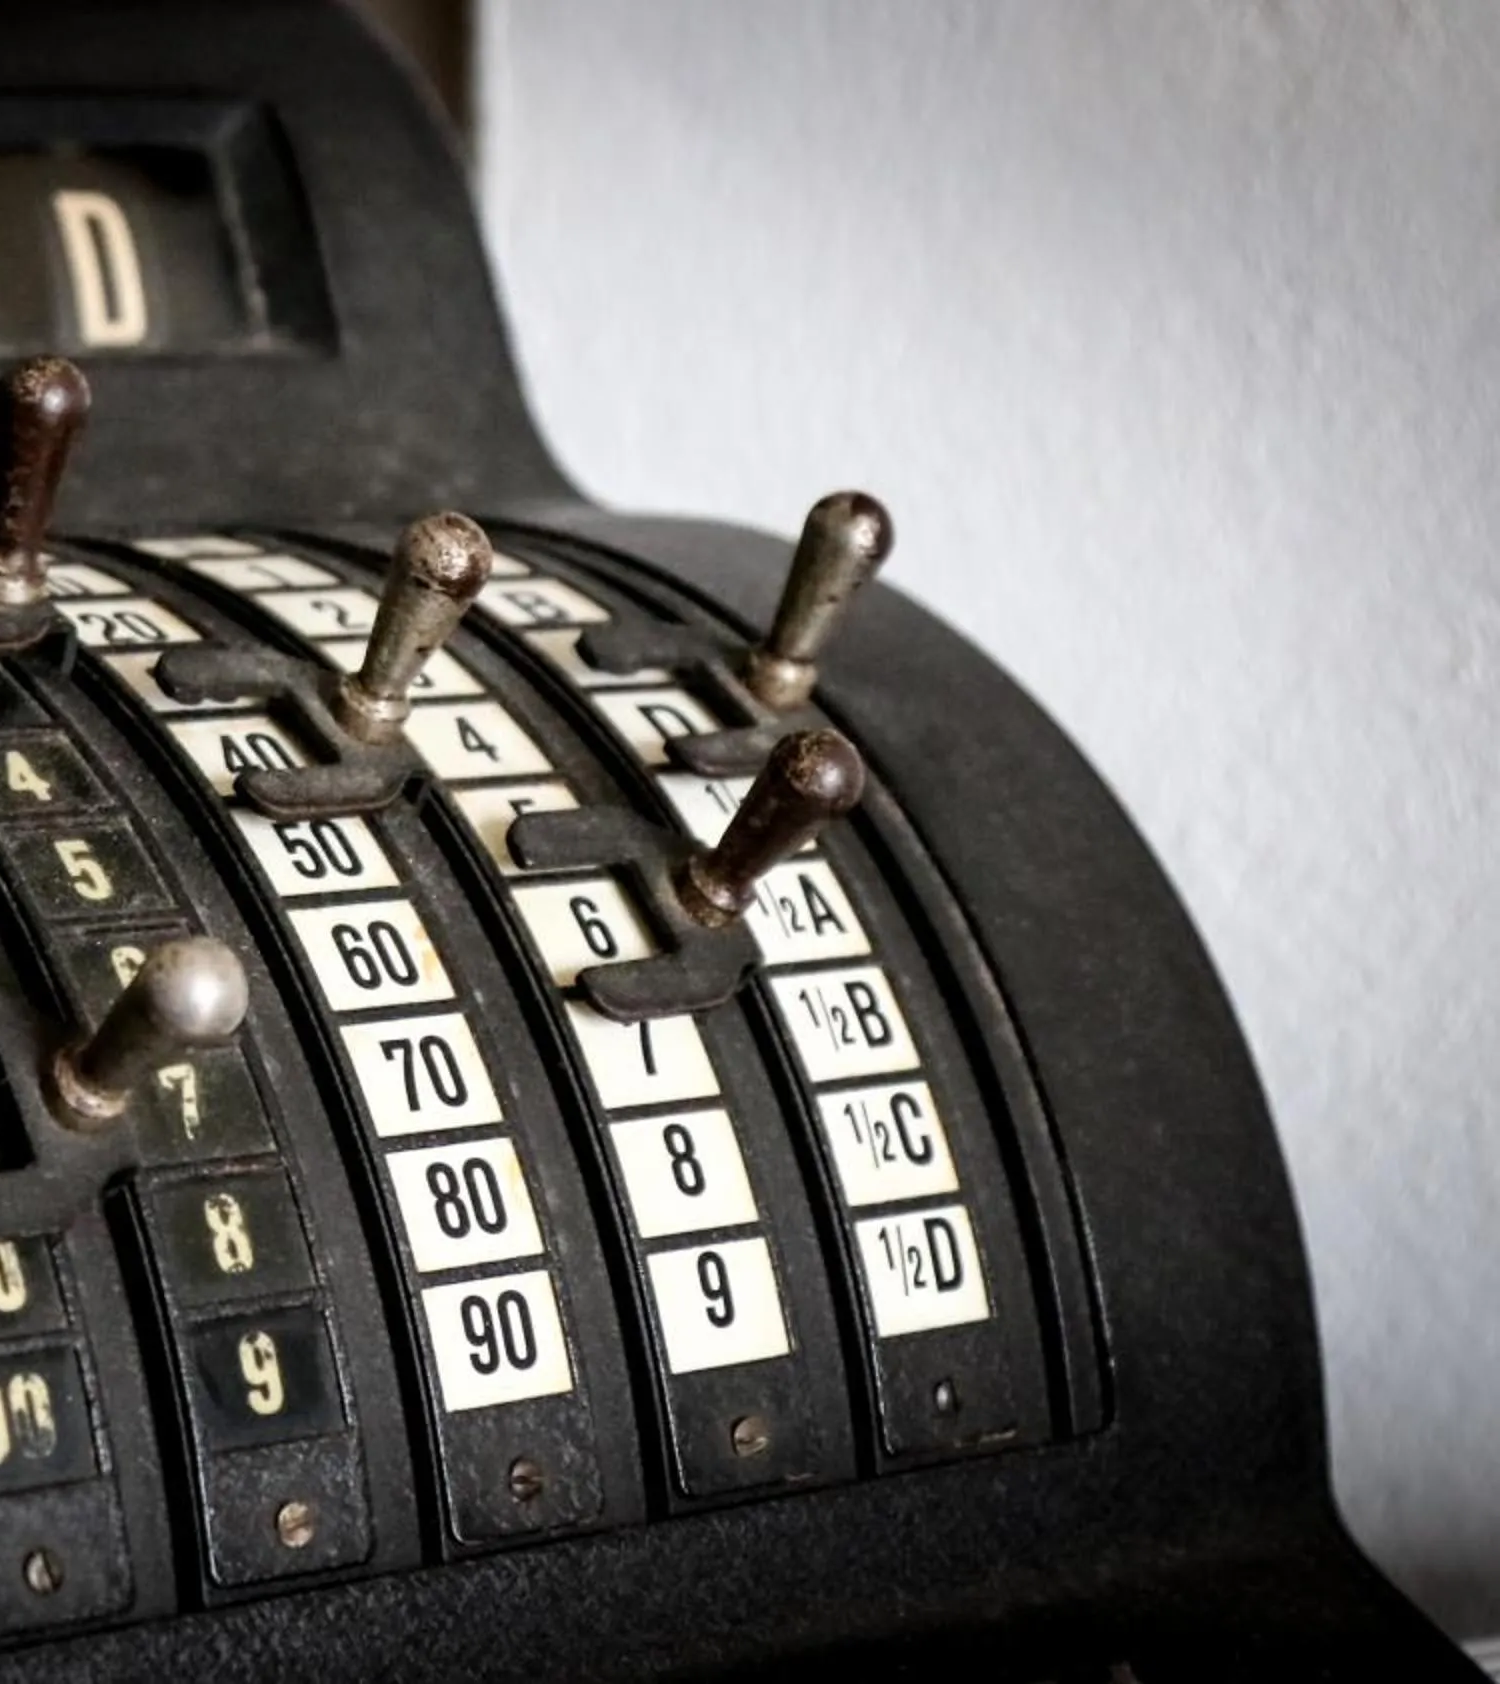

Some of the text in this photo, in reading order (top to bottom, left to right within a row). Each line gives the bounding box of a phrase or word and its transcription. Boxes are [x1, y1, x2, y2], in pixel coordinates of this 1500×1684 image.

[54, 190, 147, 347] D
[77, 611, 168, 643] 20
[310, 600, 369, 630] 2
[5, 751, 52, 801] 4
[455, 716, 501, 763] 4
[54, 839, 113, 901] 5
[273, 819, 364, 880] 50
[330, 920, 420, 990] 60
[568, 896, 619, 959] 6
[156, 1062, 202, 1140] 7
[379, 1034, 469, 1113] 70
[424, 1156, 509, 1240] 80
[662, 1122, 707, 1198] 8
[204, 1192, 255, 1275] 8
[696, 1250, 737, 1329] 9
[459, 1288, 538, 1376] 90
[237, 1330, 285, 1417] 9
